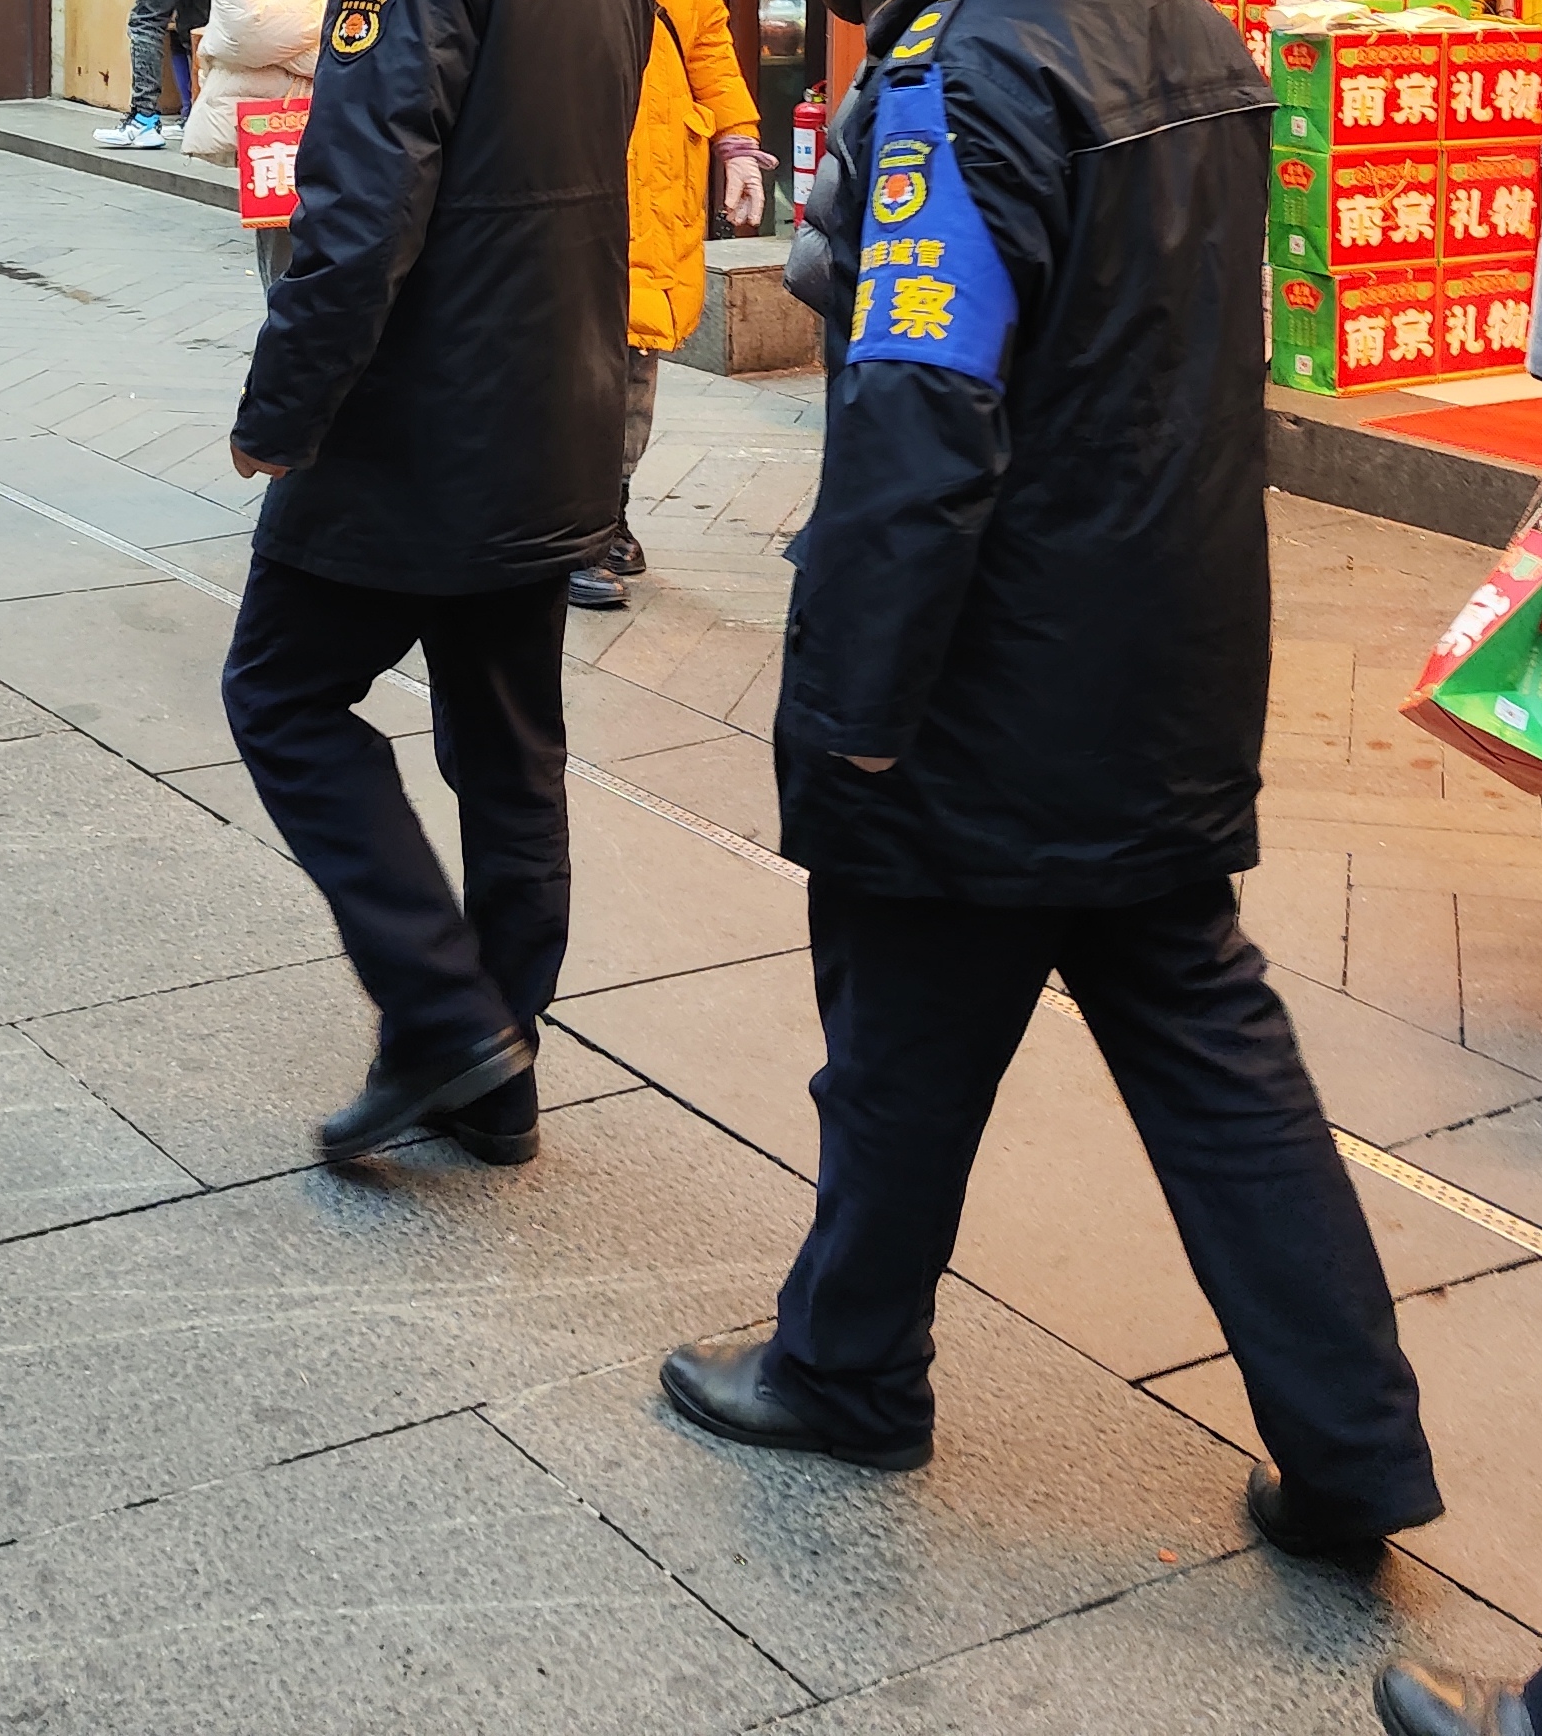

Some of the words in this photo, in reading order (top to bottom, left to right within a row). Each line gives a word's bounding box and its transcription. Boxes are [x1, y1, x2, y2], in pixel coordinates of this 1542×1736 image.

[1338, 71, 1439, 128] 南京
[1335, 189, 1437, 249] 南京
[1448, 184, 1538, 240] 礼物
[1342, 307, 1435, 370] 南京
[1443, 298, 1532, 357] 礼物
